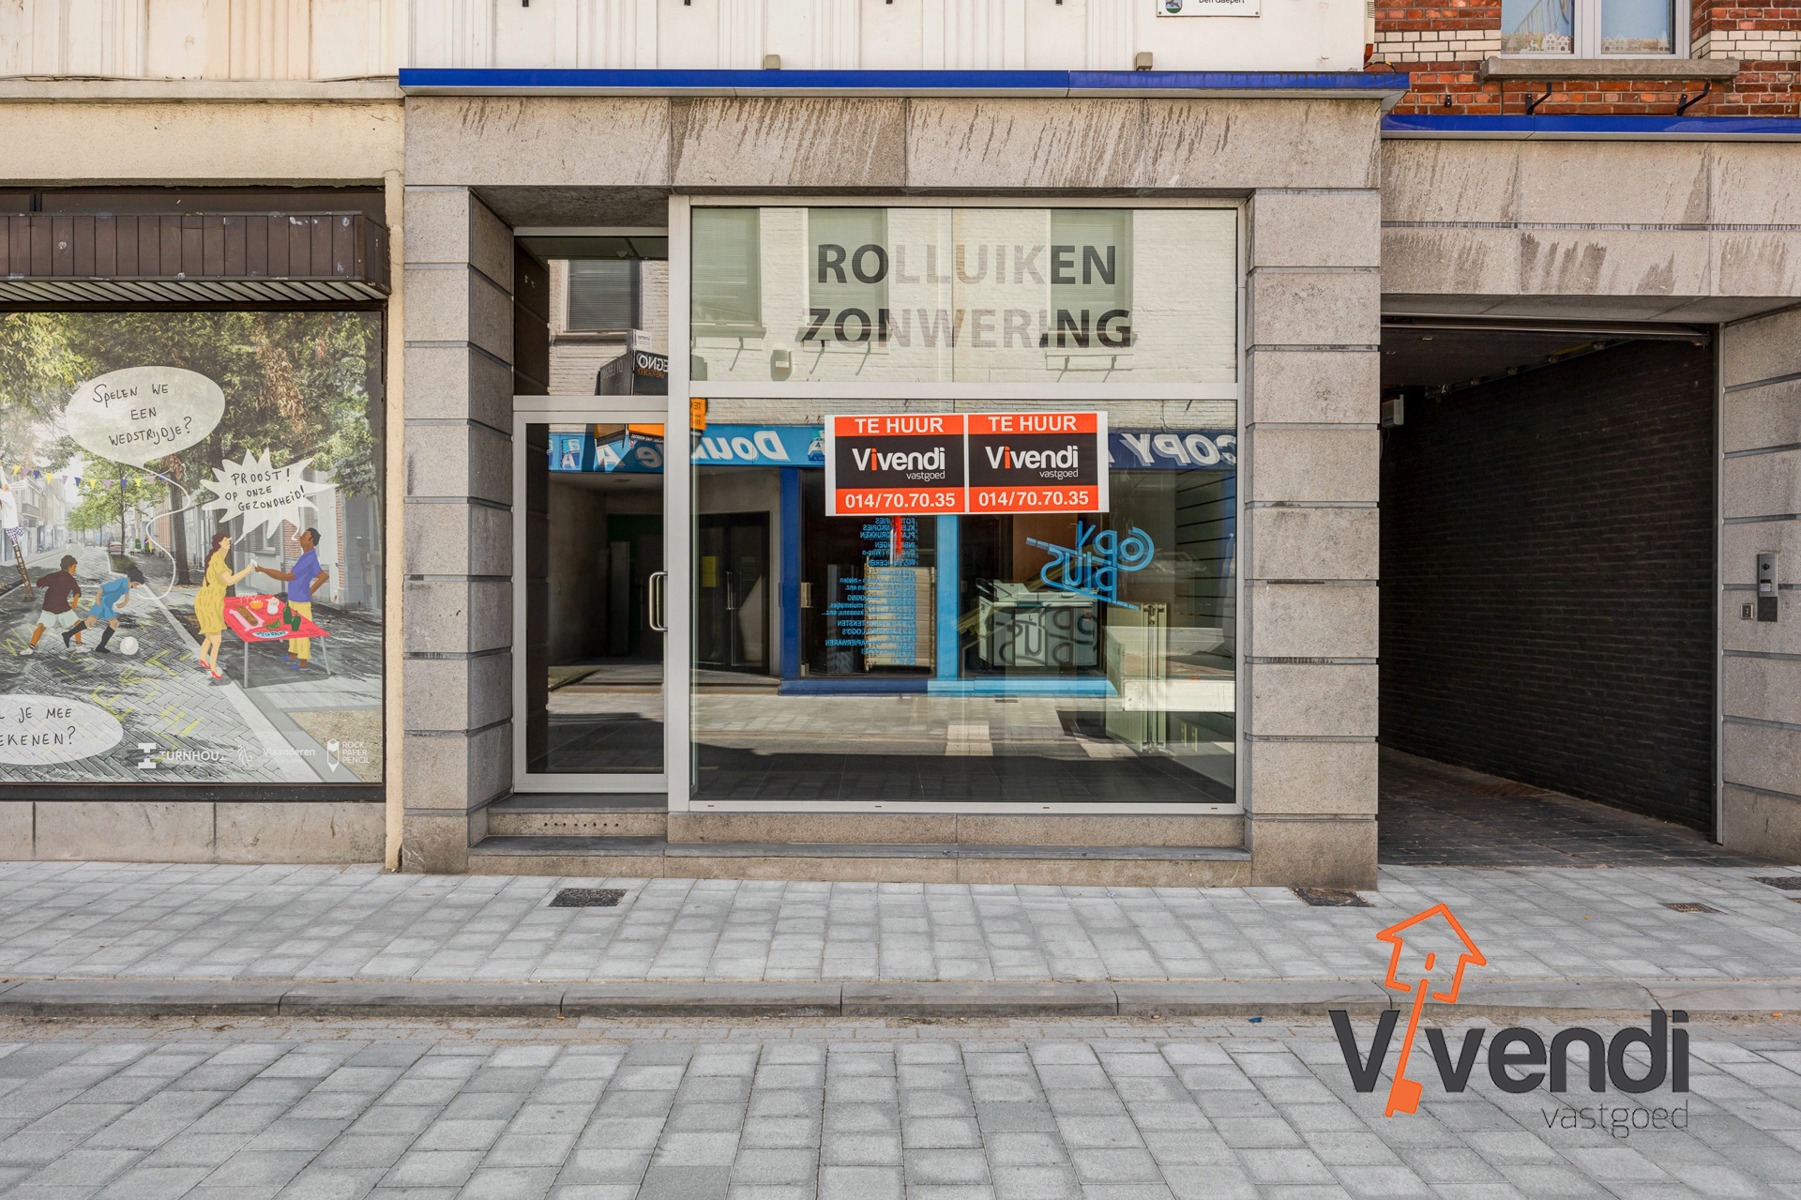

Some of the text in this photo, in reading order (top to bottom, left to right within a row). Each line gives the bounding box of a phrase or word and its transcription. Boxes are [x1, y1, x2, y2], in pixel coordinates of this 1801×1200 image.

[817, 243, 1116, 285] ROLLUIKEN
[801, 307, 1131, 348] ZONWERING
[152, 383, 169, 396] WE
[130, 406, 157, 421] EEN
[855, 416, 944, 434] TE HUUR
[988, 415, 1077, 432] TE HUUR
[852, 447, 946, 472] Vivendi
[985, 444, 1079, 470] Vivendi
[906, 470, 946, 482] vastgoed
[1039, 468, 1079, 479] vastgoed
[225, 485, 273, 501] OP ONZE
[845, 492, 956, 509] 014/70.70.35
[978, 490, 1089, 507] 014/70.70.35
[18, 706, 72, 724] JE MEE
[0, 725, 76, 747] EKENEN?
[342, 741, 365, 749] ROCK
